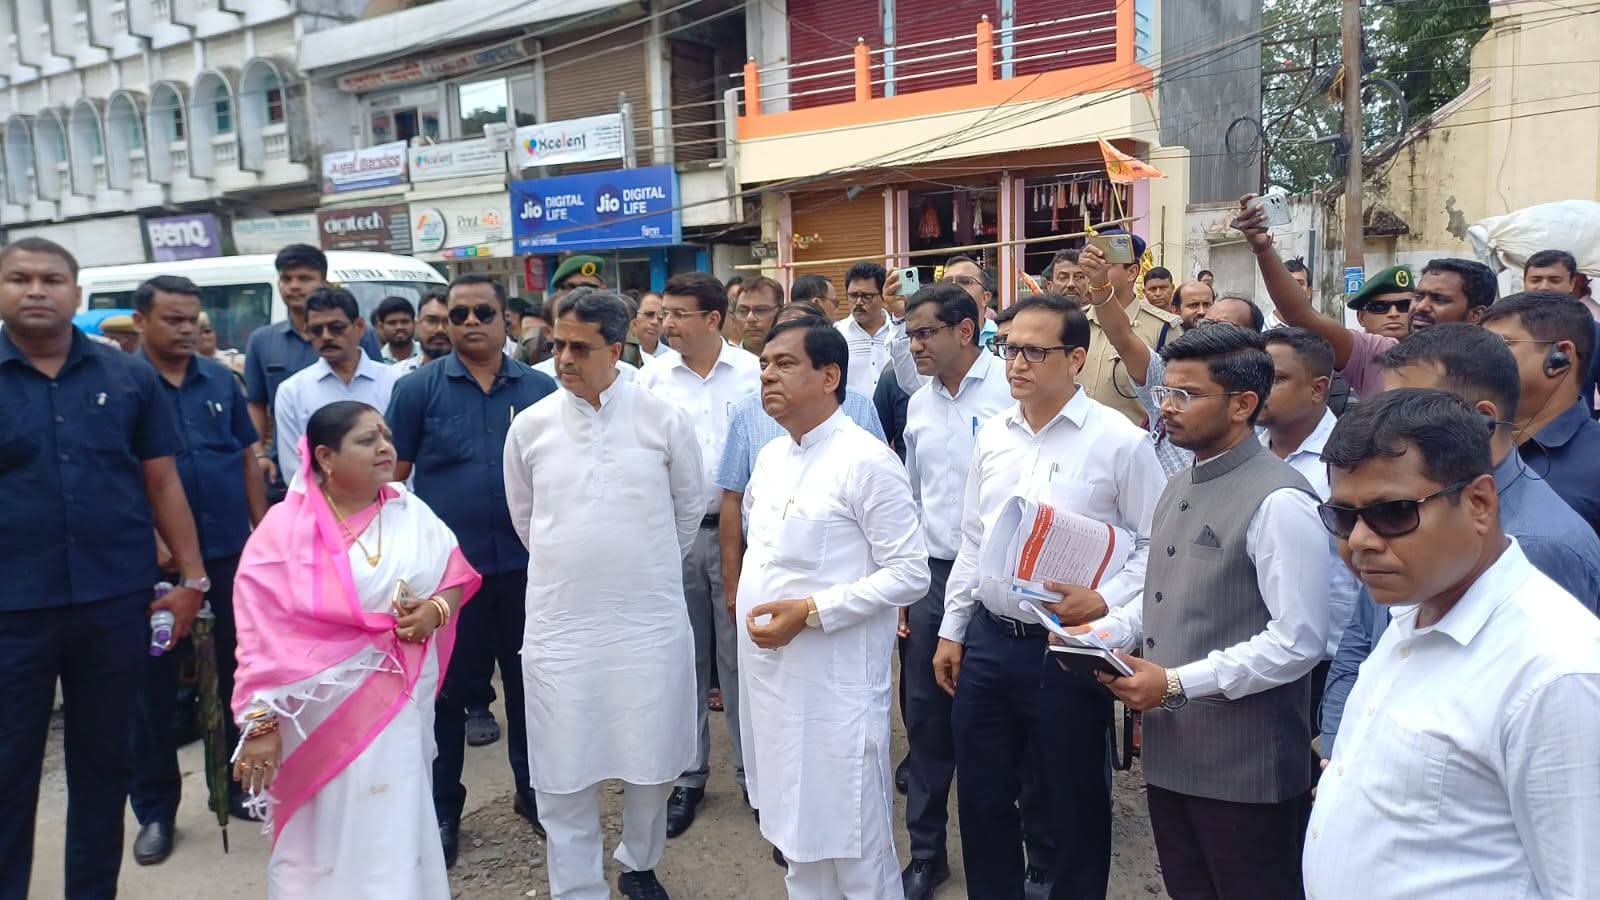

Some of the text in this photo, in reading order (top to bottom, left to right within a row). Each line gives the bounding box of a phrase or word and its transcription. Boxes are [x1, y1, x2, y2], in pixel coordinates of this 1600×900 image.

[520, 194, 584, 220] Jio DIGITAL
[596, 186, 665, 213] Jio DIGITAL
[623, 202, 647, 214] LIFE
[546, 208, 568, 221] LIFE
